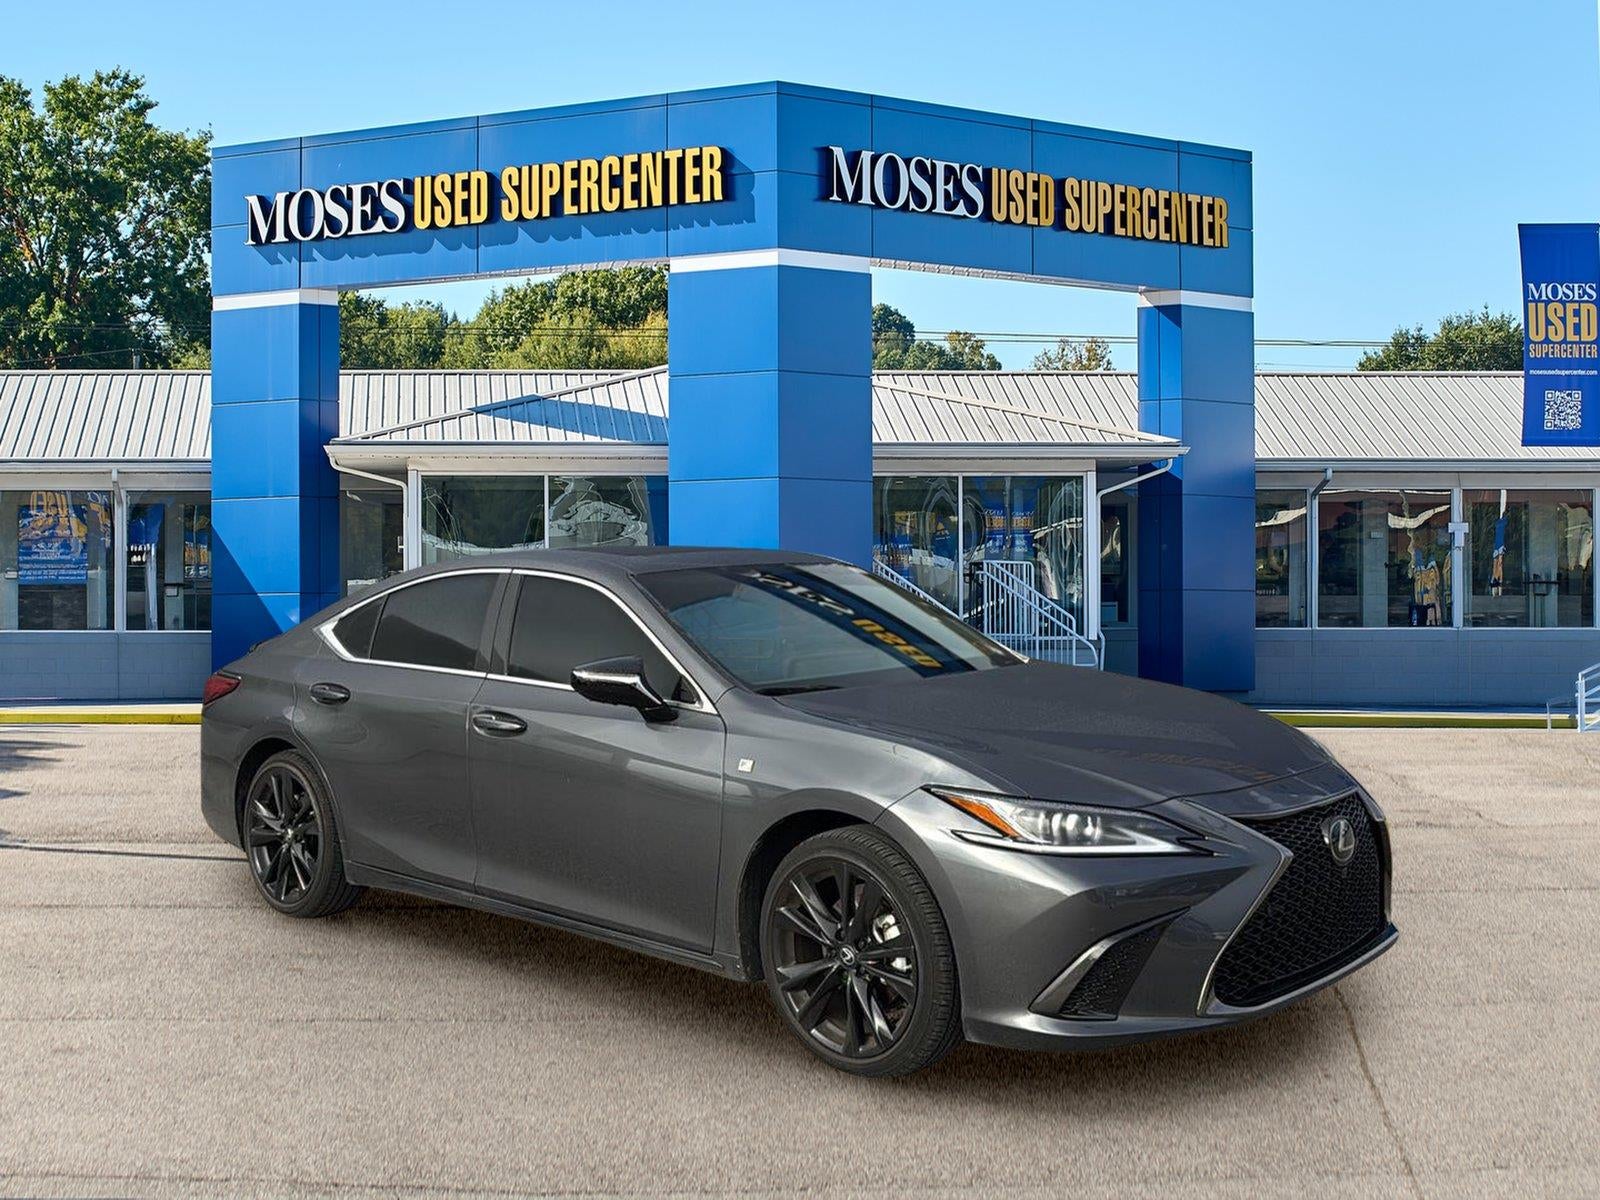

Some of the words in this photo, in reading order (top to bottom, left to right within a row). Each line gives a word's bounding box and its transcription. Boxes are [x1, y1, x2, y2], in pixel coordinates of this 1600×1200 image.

[244, 178, 407, 246] MOSES
[413, 170, 488, 230] USED
[500, 145, 724, 222] SUPERCENTER
[828, 145, 984, 219] MOSES
[991, 167, 1055, 227] USED
[1064, 177, 1229, 248] SUPERCENTER
[1528, 283, 1597, 301] MOSES
[1528, 302, 1598, 342] USED
[1530, 344, 1597, 358] SUPERCENTER
